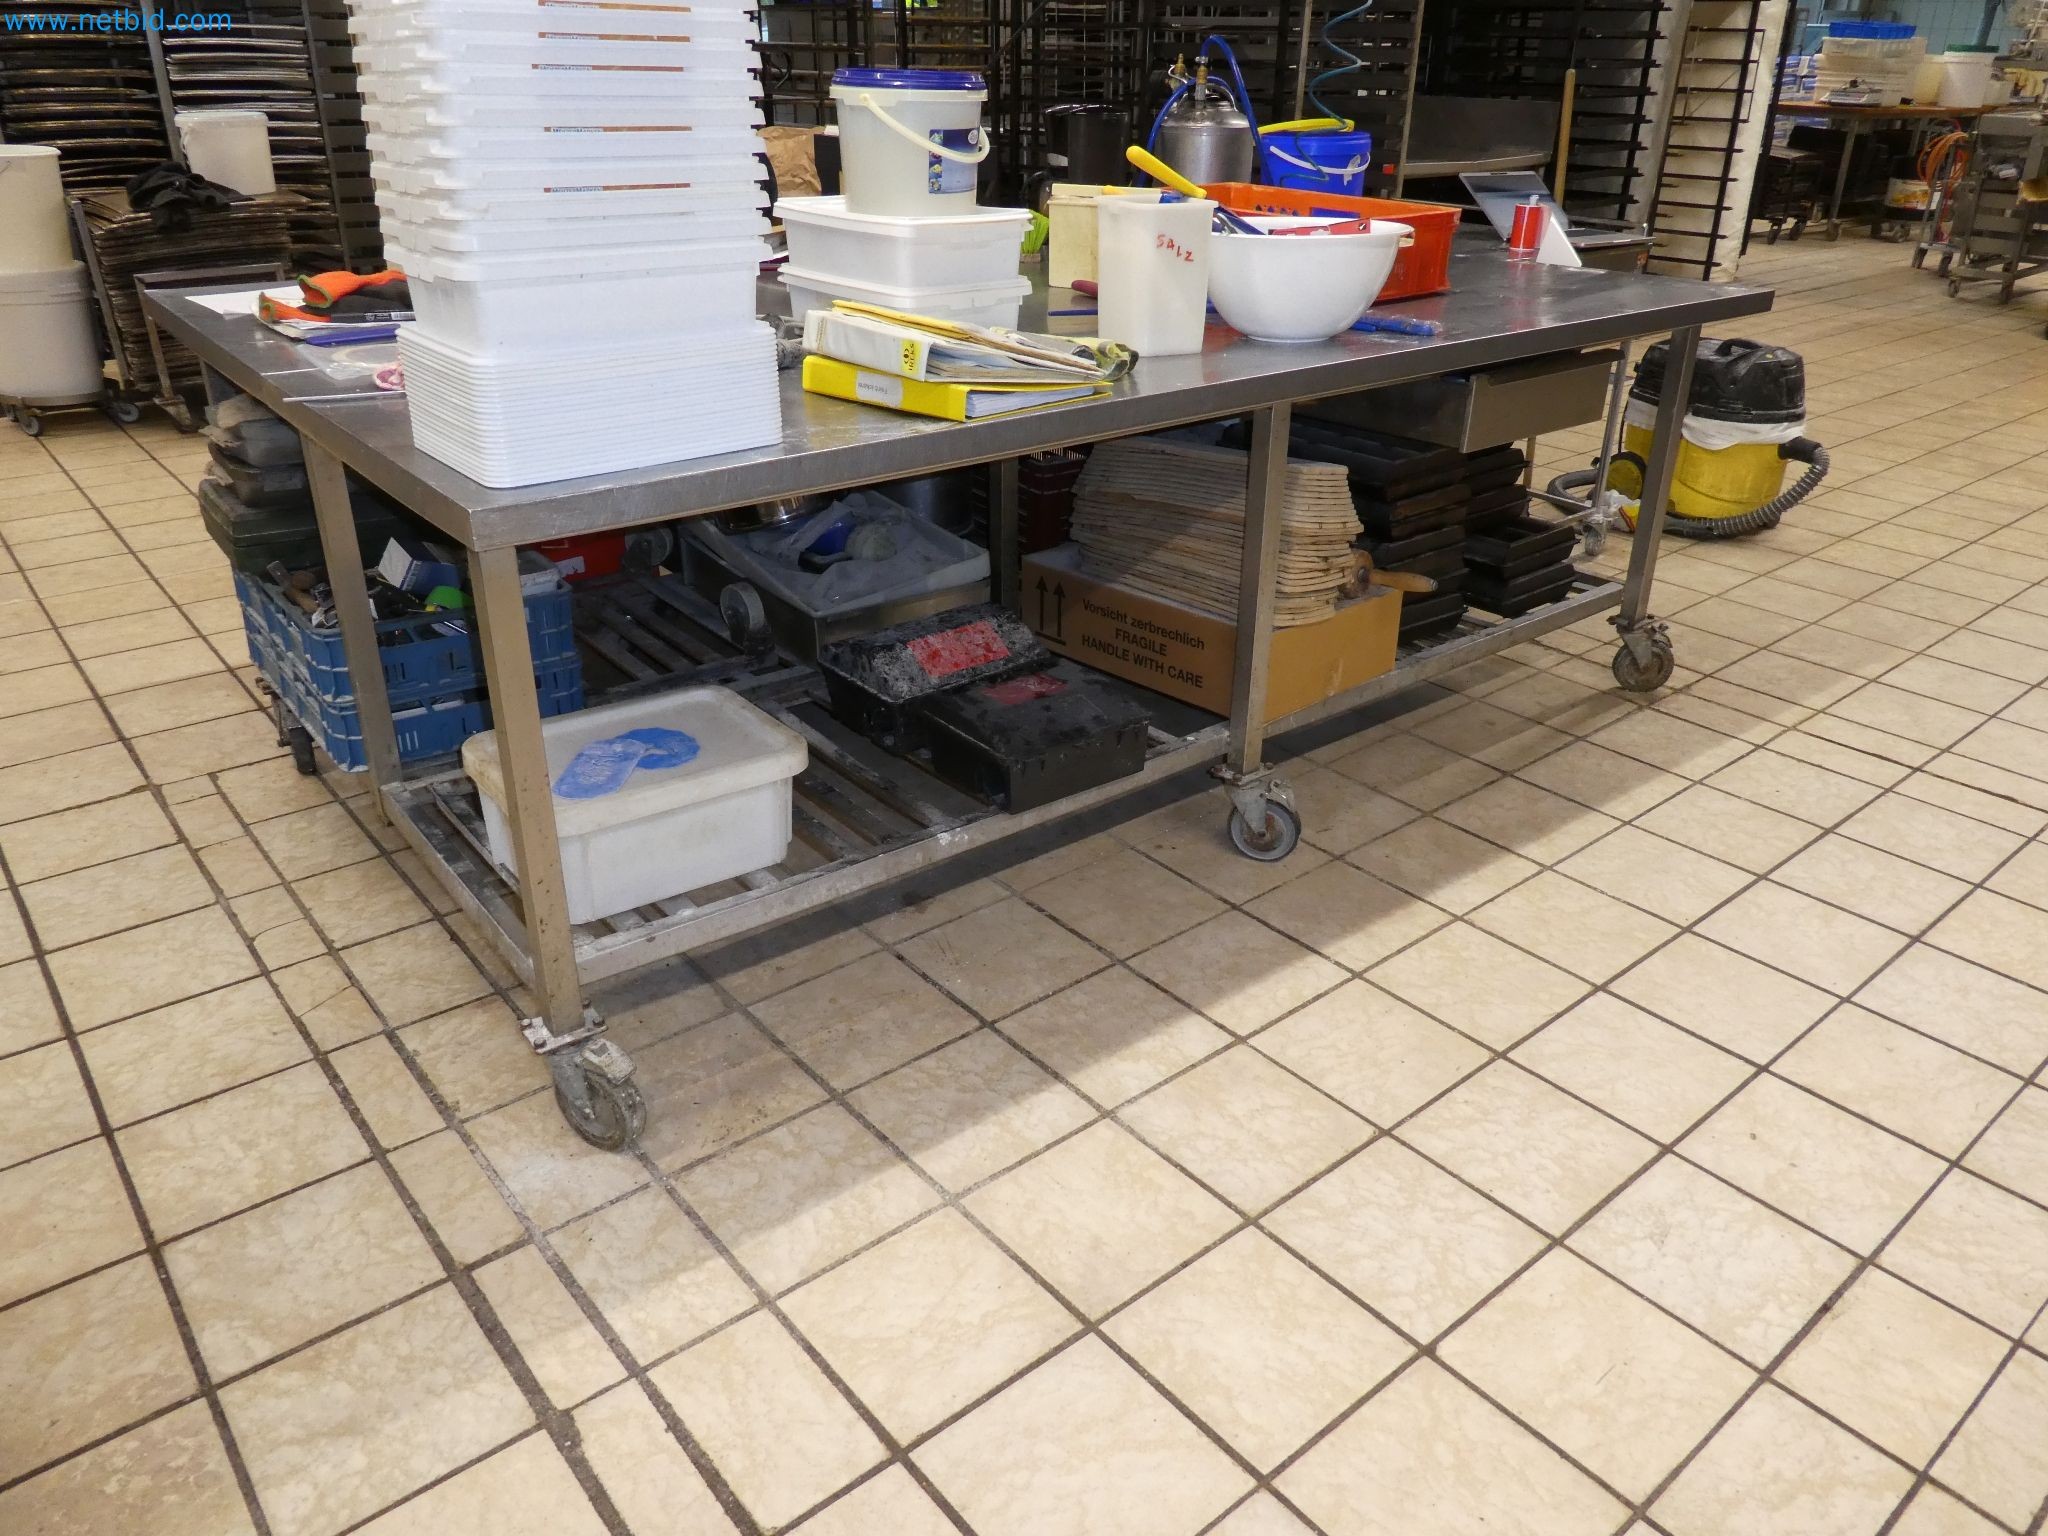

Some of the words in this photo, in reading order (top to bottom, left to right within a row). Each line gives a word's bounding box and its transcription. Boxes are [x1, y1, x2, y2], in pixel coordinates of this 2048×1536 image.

[1156, 234, 1194, 262] SALZ
[1082, 599, 1128, 624] Vorsicht
[1130, 618, 1205, 650] zerbrechlich
[1115, 628, 1167, 656] FRAGILE
[1081, 634, 1130, 661] HANDLE
[1133, 652, 1164, 674] WITH
[1167, 665, 1203, 689] CARE
